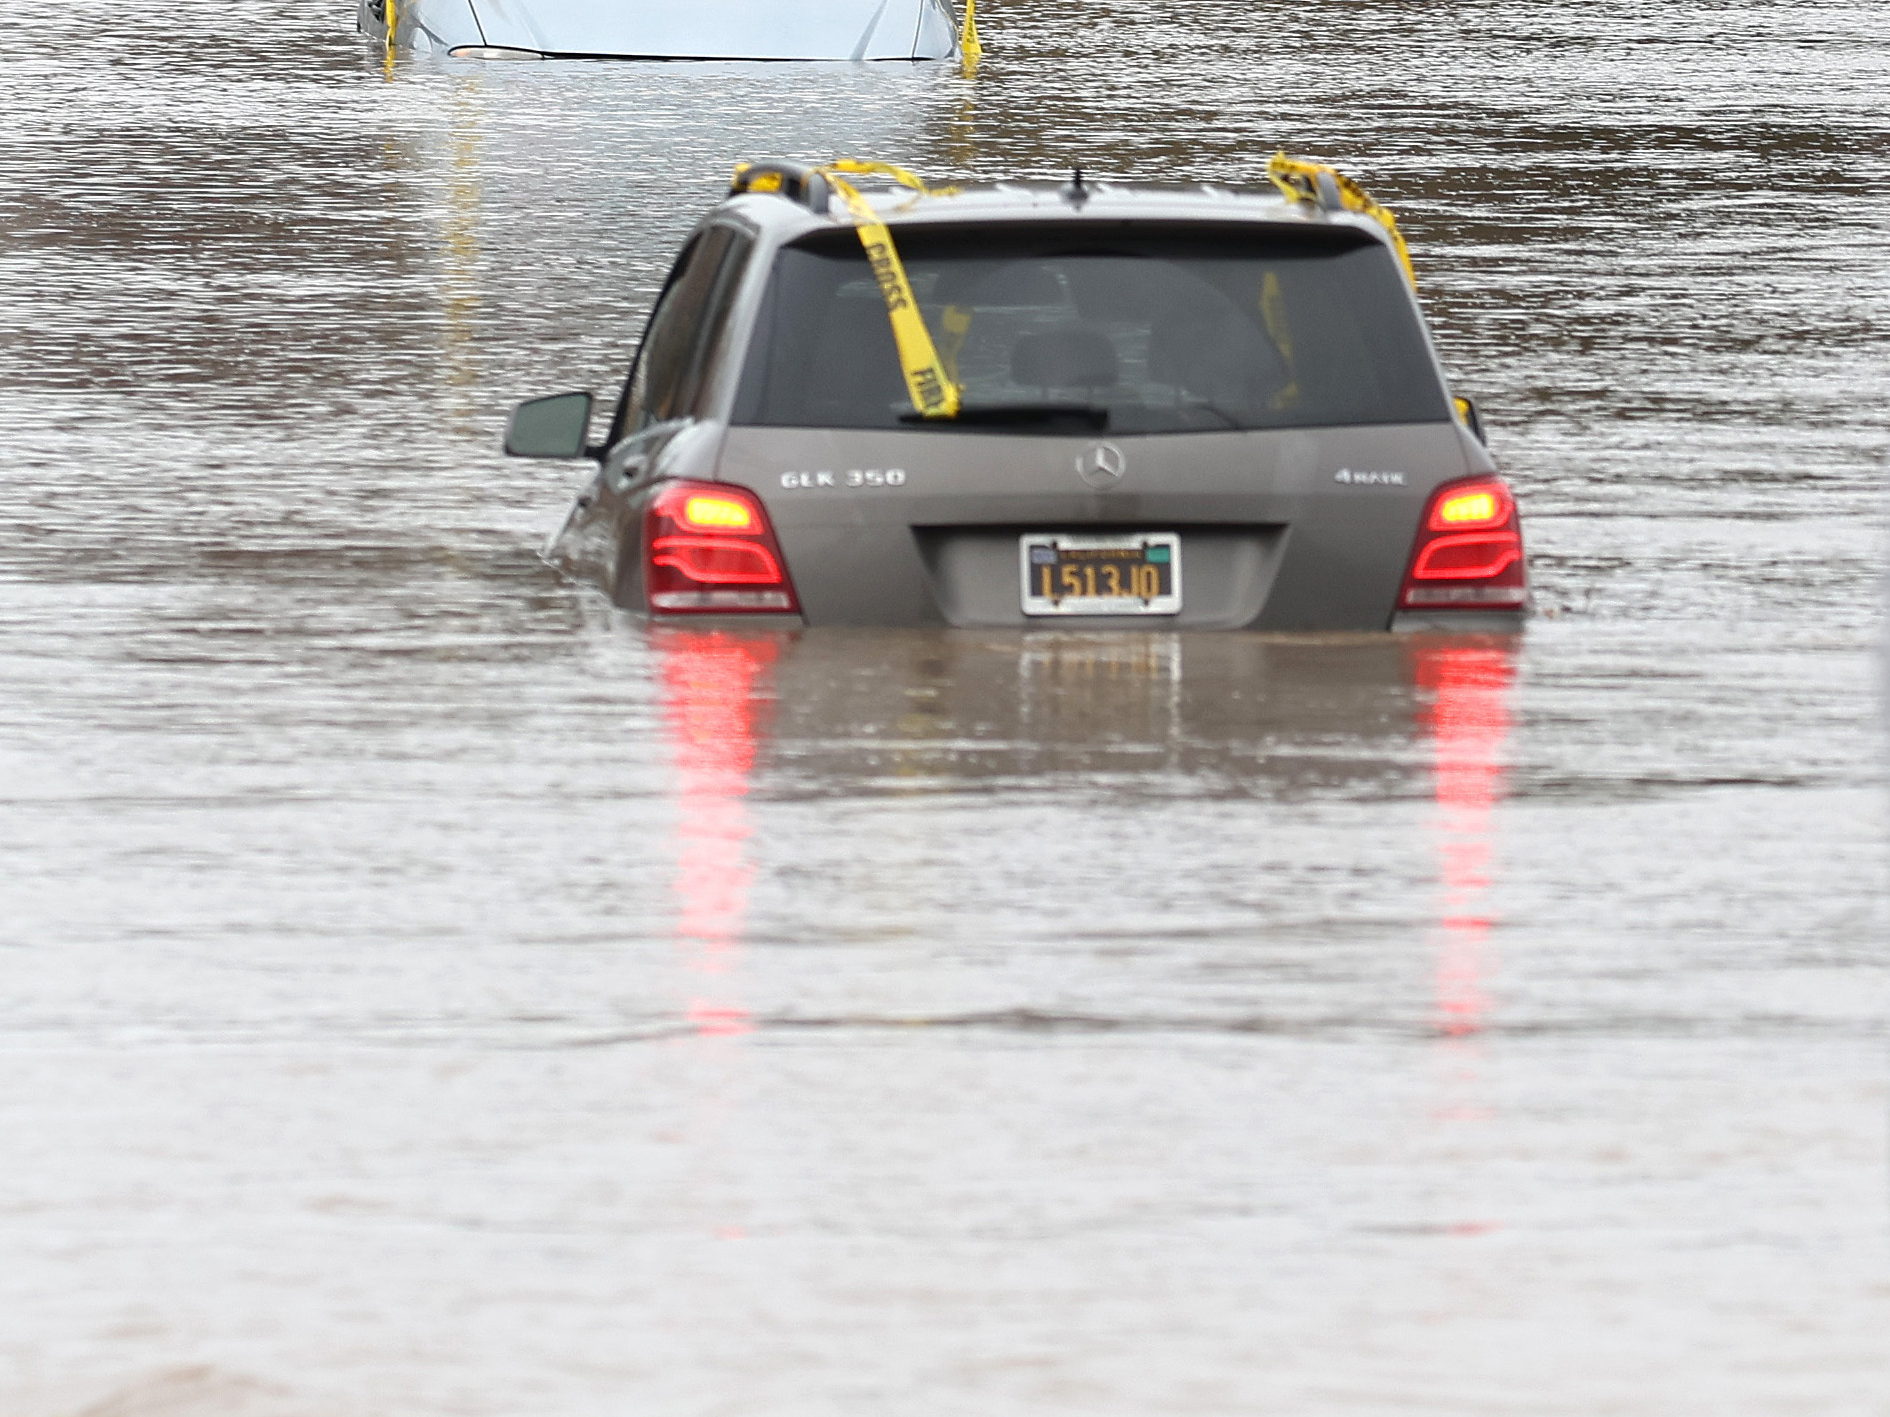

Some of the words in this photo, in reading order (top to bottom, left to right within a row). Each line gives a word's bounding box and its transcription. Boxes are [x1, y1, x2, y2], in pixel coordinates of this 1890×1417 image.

[866, 242, 907, 313] CROSS
[781, 470, 835, 489] GLK
[845, 469, 906, 487] 350
